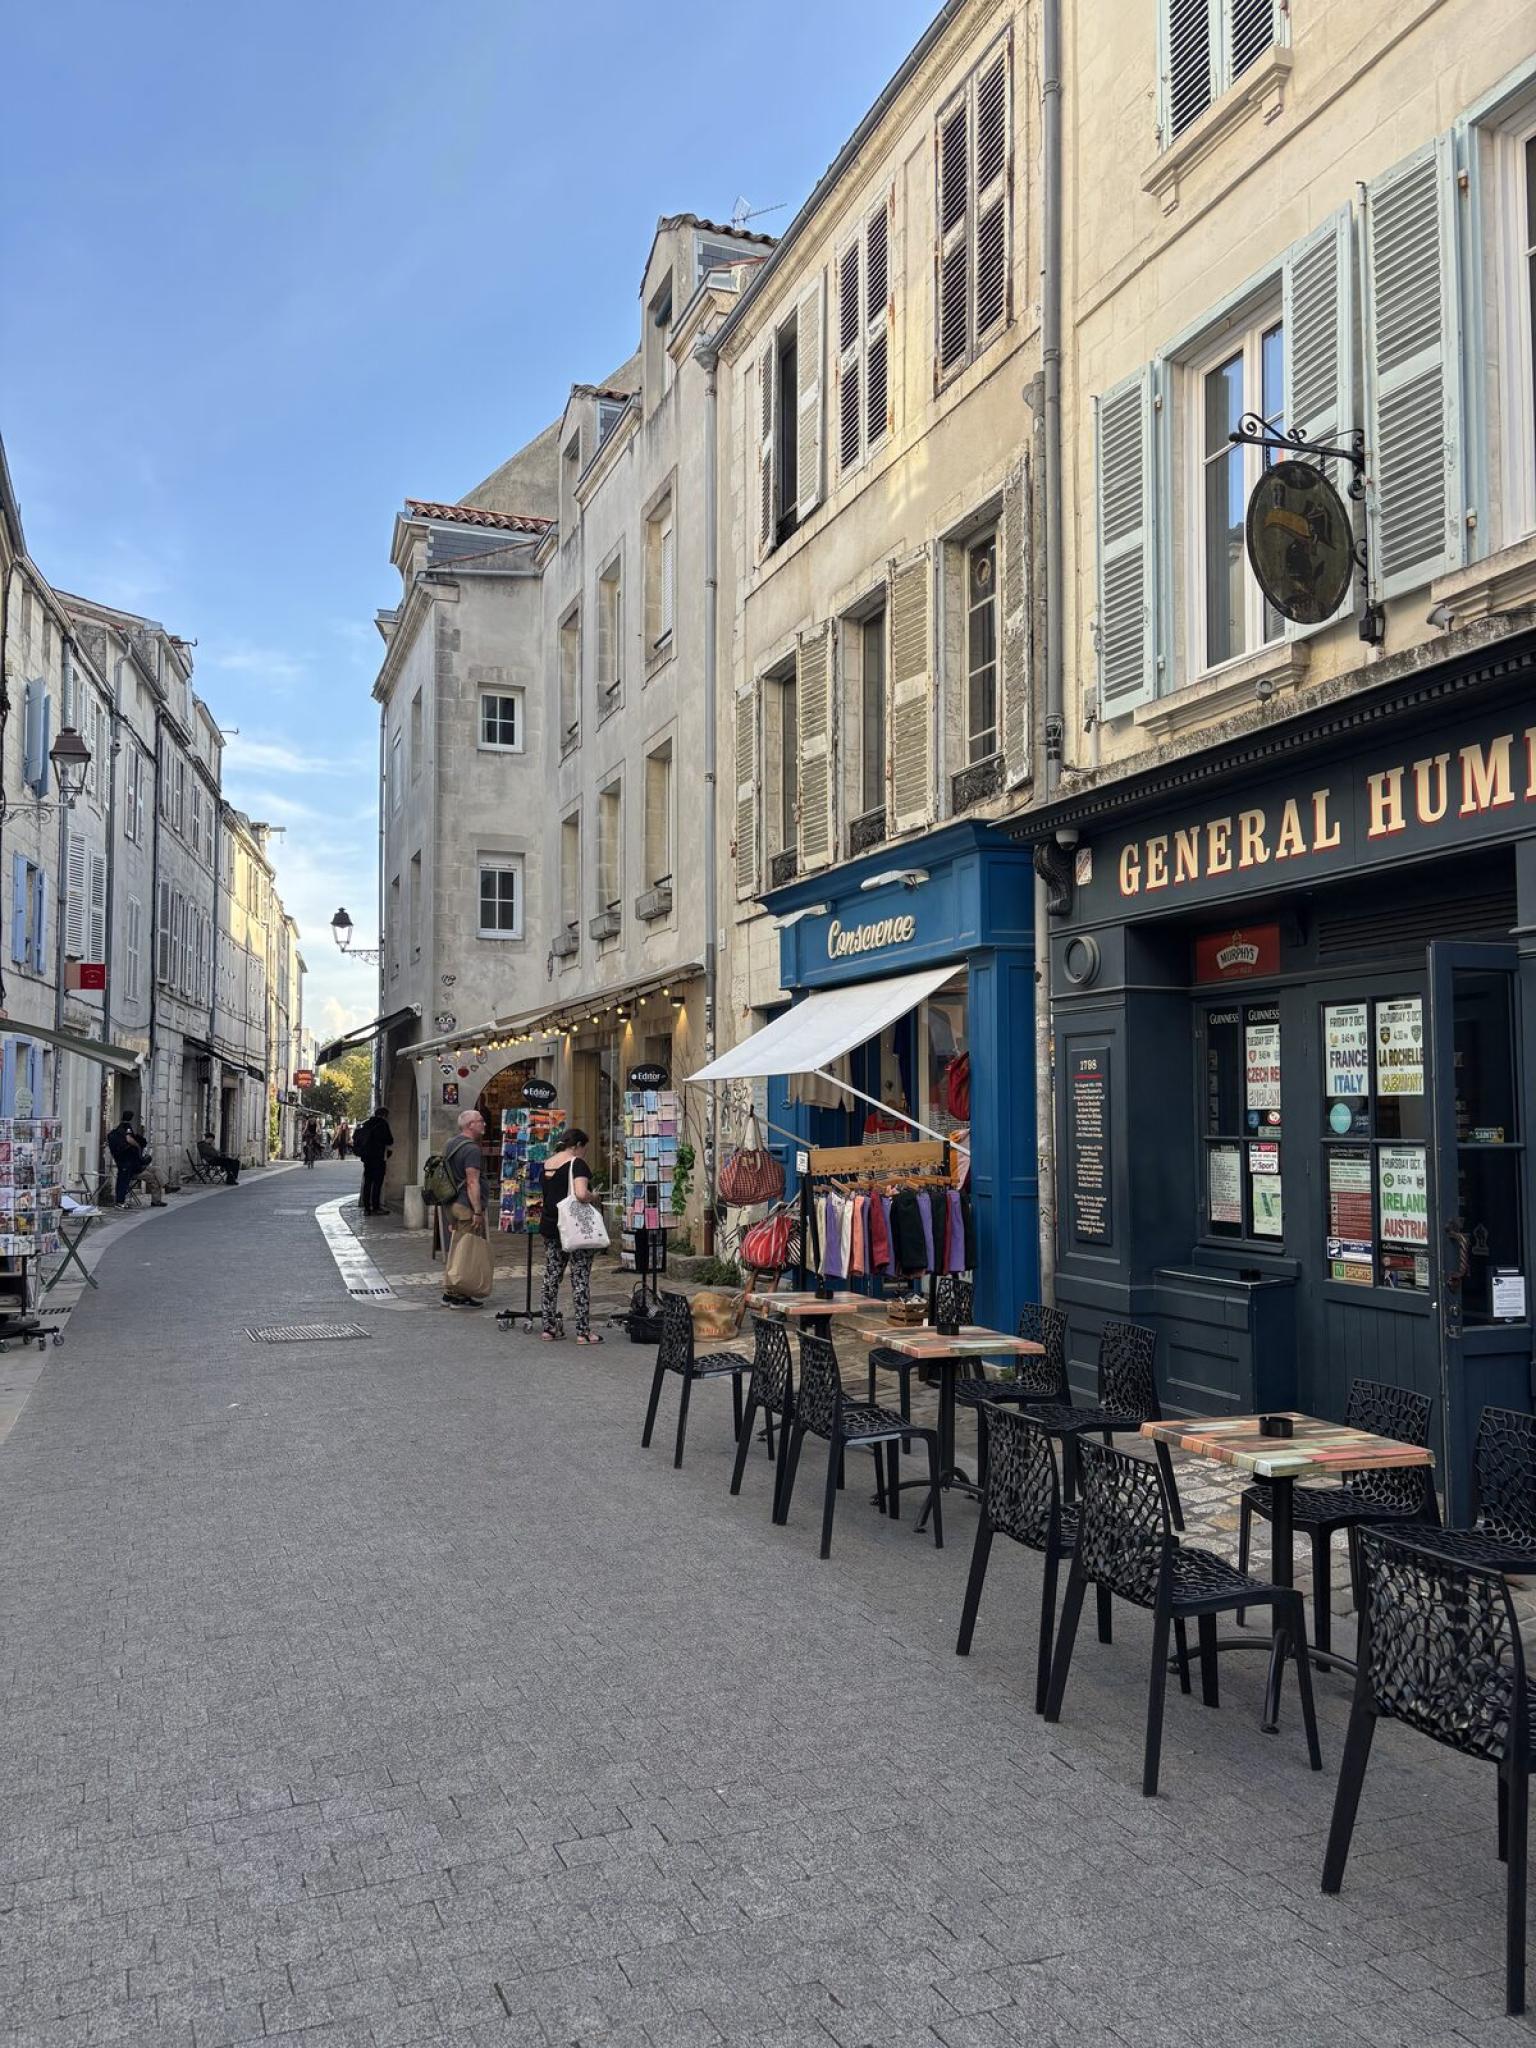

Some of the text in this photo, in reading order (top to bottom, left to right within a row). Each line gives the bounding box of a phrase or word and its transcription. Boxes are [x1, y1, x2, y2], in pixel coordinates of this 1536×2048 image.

[1119, 723, 1536, 897] GENERAL HUM
[828, 915, 915, 959] Conscience
[1330, 1017, 1347, 1027] FRIDAY
[1380, 1012, 1404, 1024] SATURDAY
[1330, 1049, 1368, 1068] FRANCE
[1379, 1048, 1424, 1067] LA ROCHELLE
[1334, 1075, 1363, 1093] ITALY
[1382, 1159, 1409, 1169] THURSDAY
[1382, 1193, 1426, 1213] IRELAND
[1384, 1218, 1427, 1239] AUSTRIA
